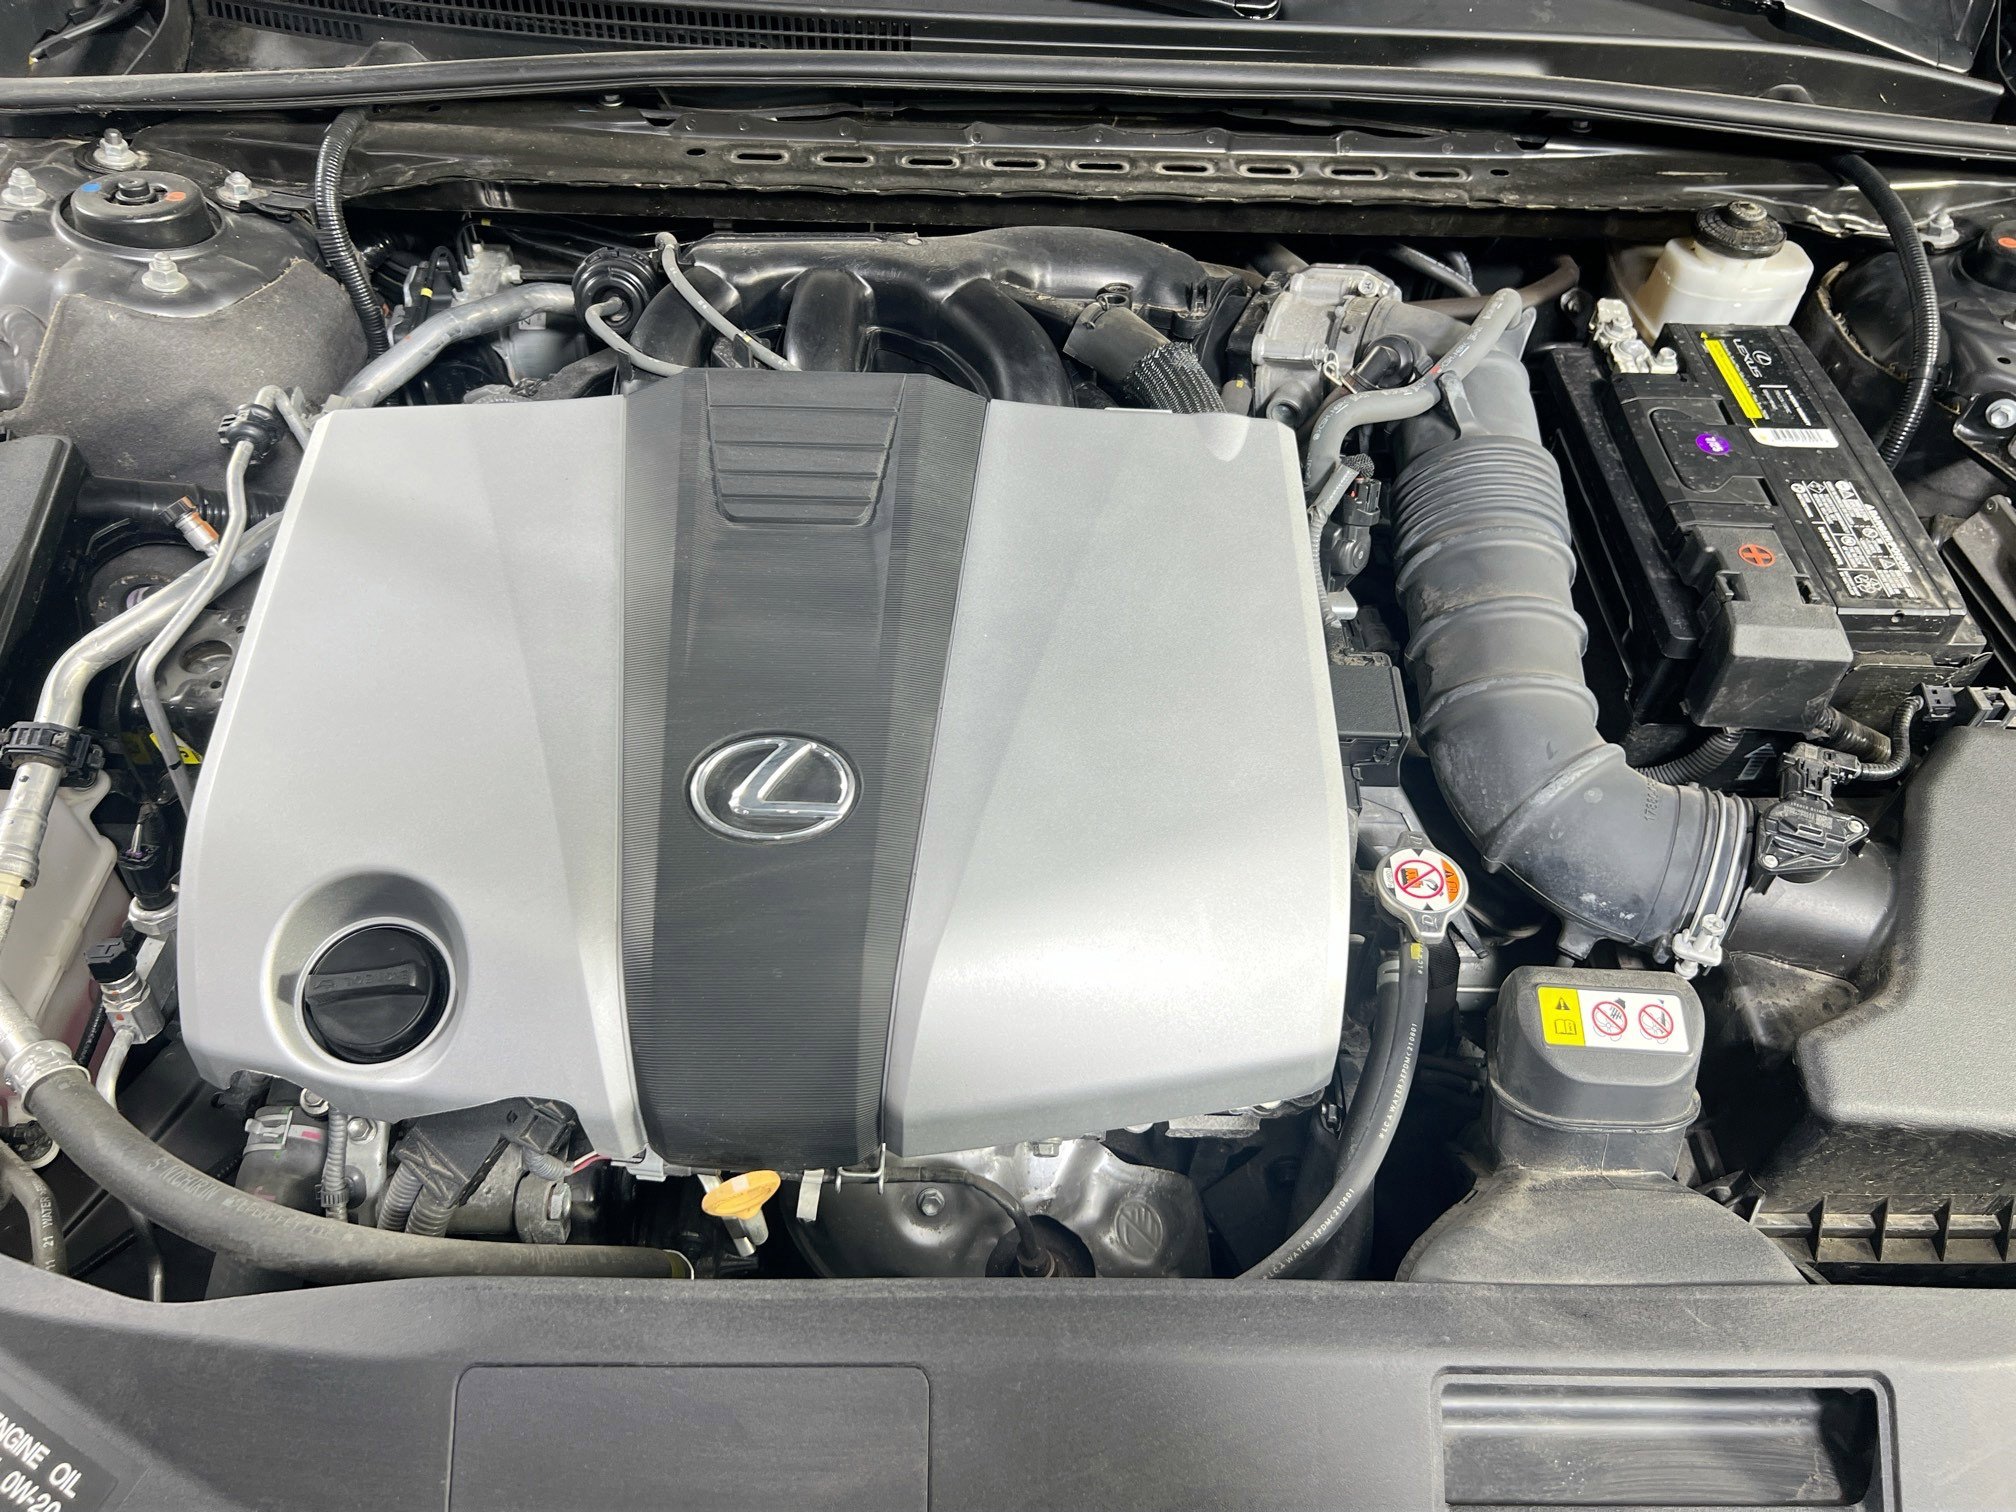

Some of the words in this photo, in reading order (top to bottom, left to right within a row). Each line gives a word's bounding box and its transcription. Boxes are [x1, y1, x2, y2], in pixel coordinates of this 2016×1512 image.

[1732, 338, 1763, 378] LEXUS
[0, 1411, 51, 1470] NGINE
[49, 1462, 82, 1499] OIL
